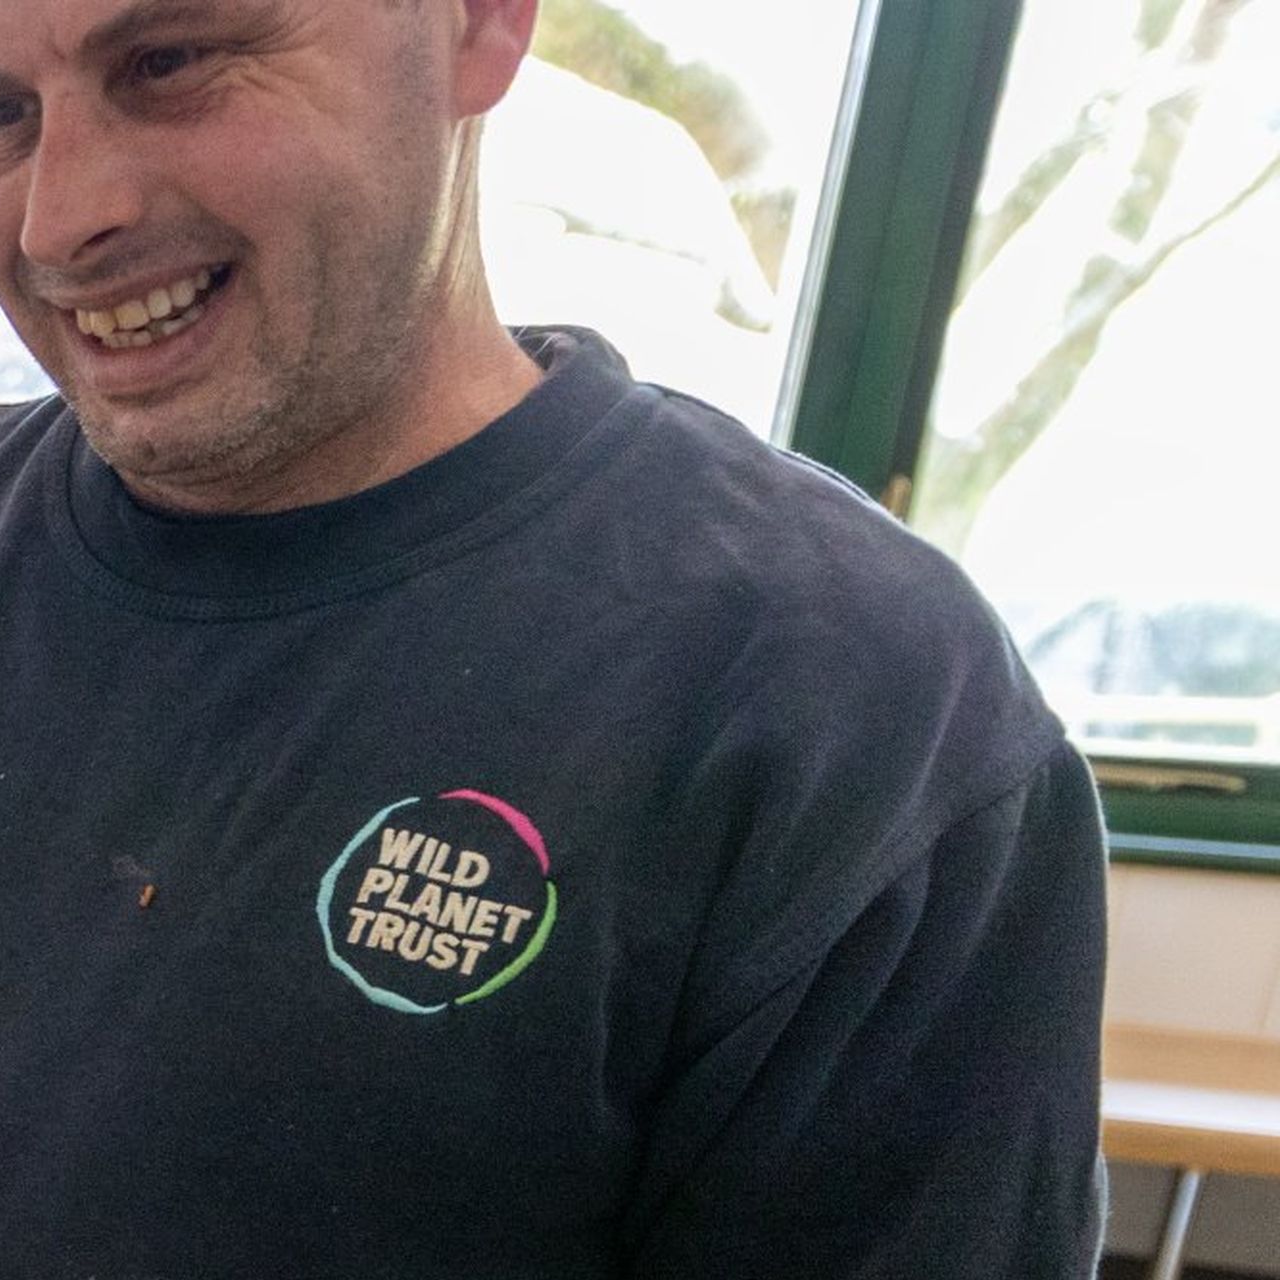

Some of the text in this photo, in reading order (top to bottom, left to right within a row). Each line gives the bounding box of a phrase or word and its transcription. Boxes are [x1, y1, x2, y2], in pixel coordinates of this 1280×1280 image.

[378, 827, 490, 888] WILD
[355, 867, 533, 944] PLANET
[346, 906, 490, 976] TRUST
